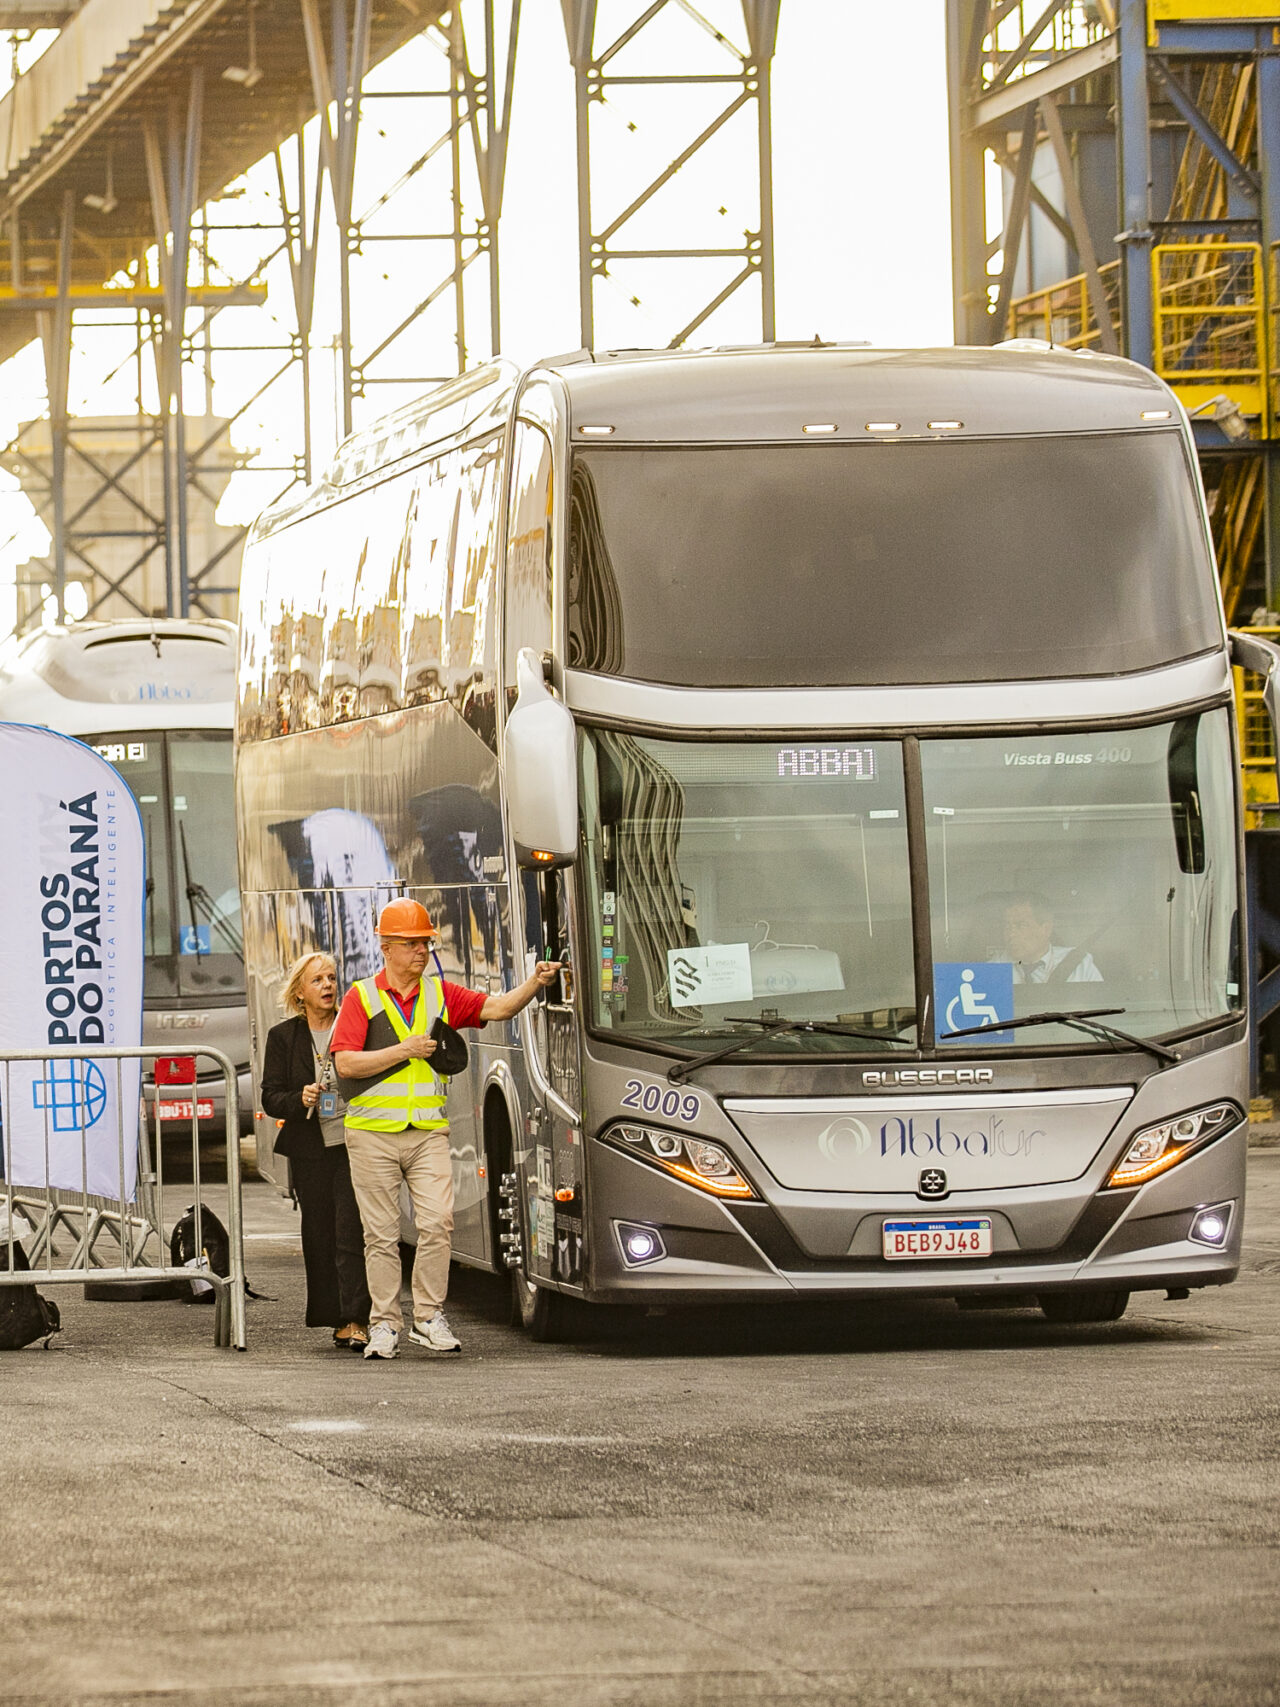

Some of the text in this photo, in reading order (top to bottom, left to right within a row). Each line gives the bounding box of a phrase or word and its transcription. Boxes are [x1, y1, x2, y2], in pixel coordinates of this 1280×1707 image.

[1003, 747, 1132, 766] Vissta Buss 400
[106, 789, 117, 923] INTELIGENTE
[59, 790, 105, 1044] DO PARANÁ
[39, 873, 78, 1045] PORTOS
[156, 1012, 210, 1029] Irizar
[862, 1068, 994, 1088] BUSSCAR
[620, 1079, 701, 1123] 2009
[880, 1114, 1048, 1157] Abbatur
[894, 1231, 981, 1254] BEB9J48
